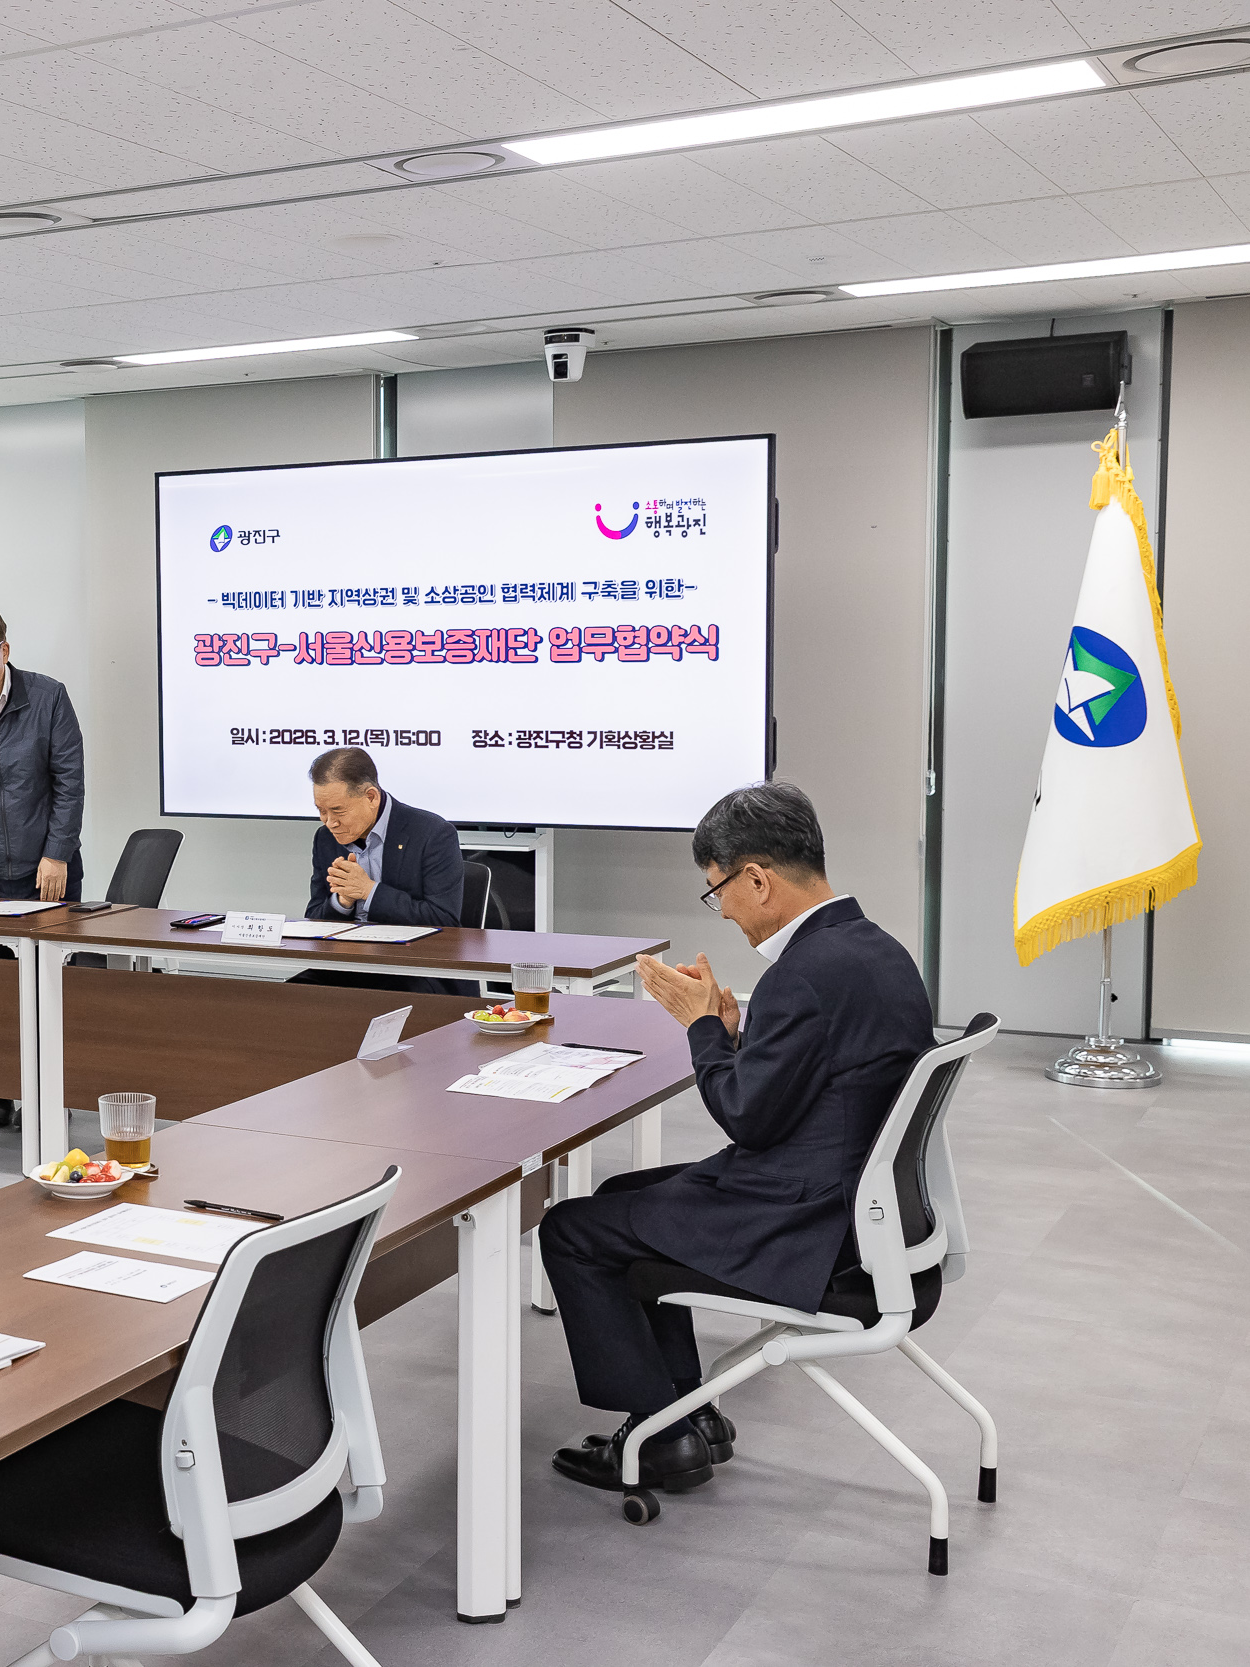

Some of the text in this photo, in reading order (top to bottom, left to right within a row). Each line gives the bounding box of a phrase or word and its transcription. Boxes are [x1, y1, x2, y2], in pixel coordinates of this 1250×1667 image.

[645, 498, 706, 514] 소통하며 발전하는
[645, 512, 706, 538] 행복광진
[237, 529, 281, 546] 광진구
[221, 590, 286, 610] 빅데이터
[290, 589, 325, 608] 기반
[328, 587, 397, 607] 지역상권
[401, 586, 419, 605] 및
[423, 584, 496, 605] 소상공인
[500, 581, 576, 603] 협력체계
[581, 579, 639, 600] 구축을
[194, 624, 720, 667] 광진구-서울신용보증재단 업무협약식
[393, 729, 442, 747] 15:00
[516, 729, 583, 749] 광진구청
[587, 730, 674, 750] 기획상황실
